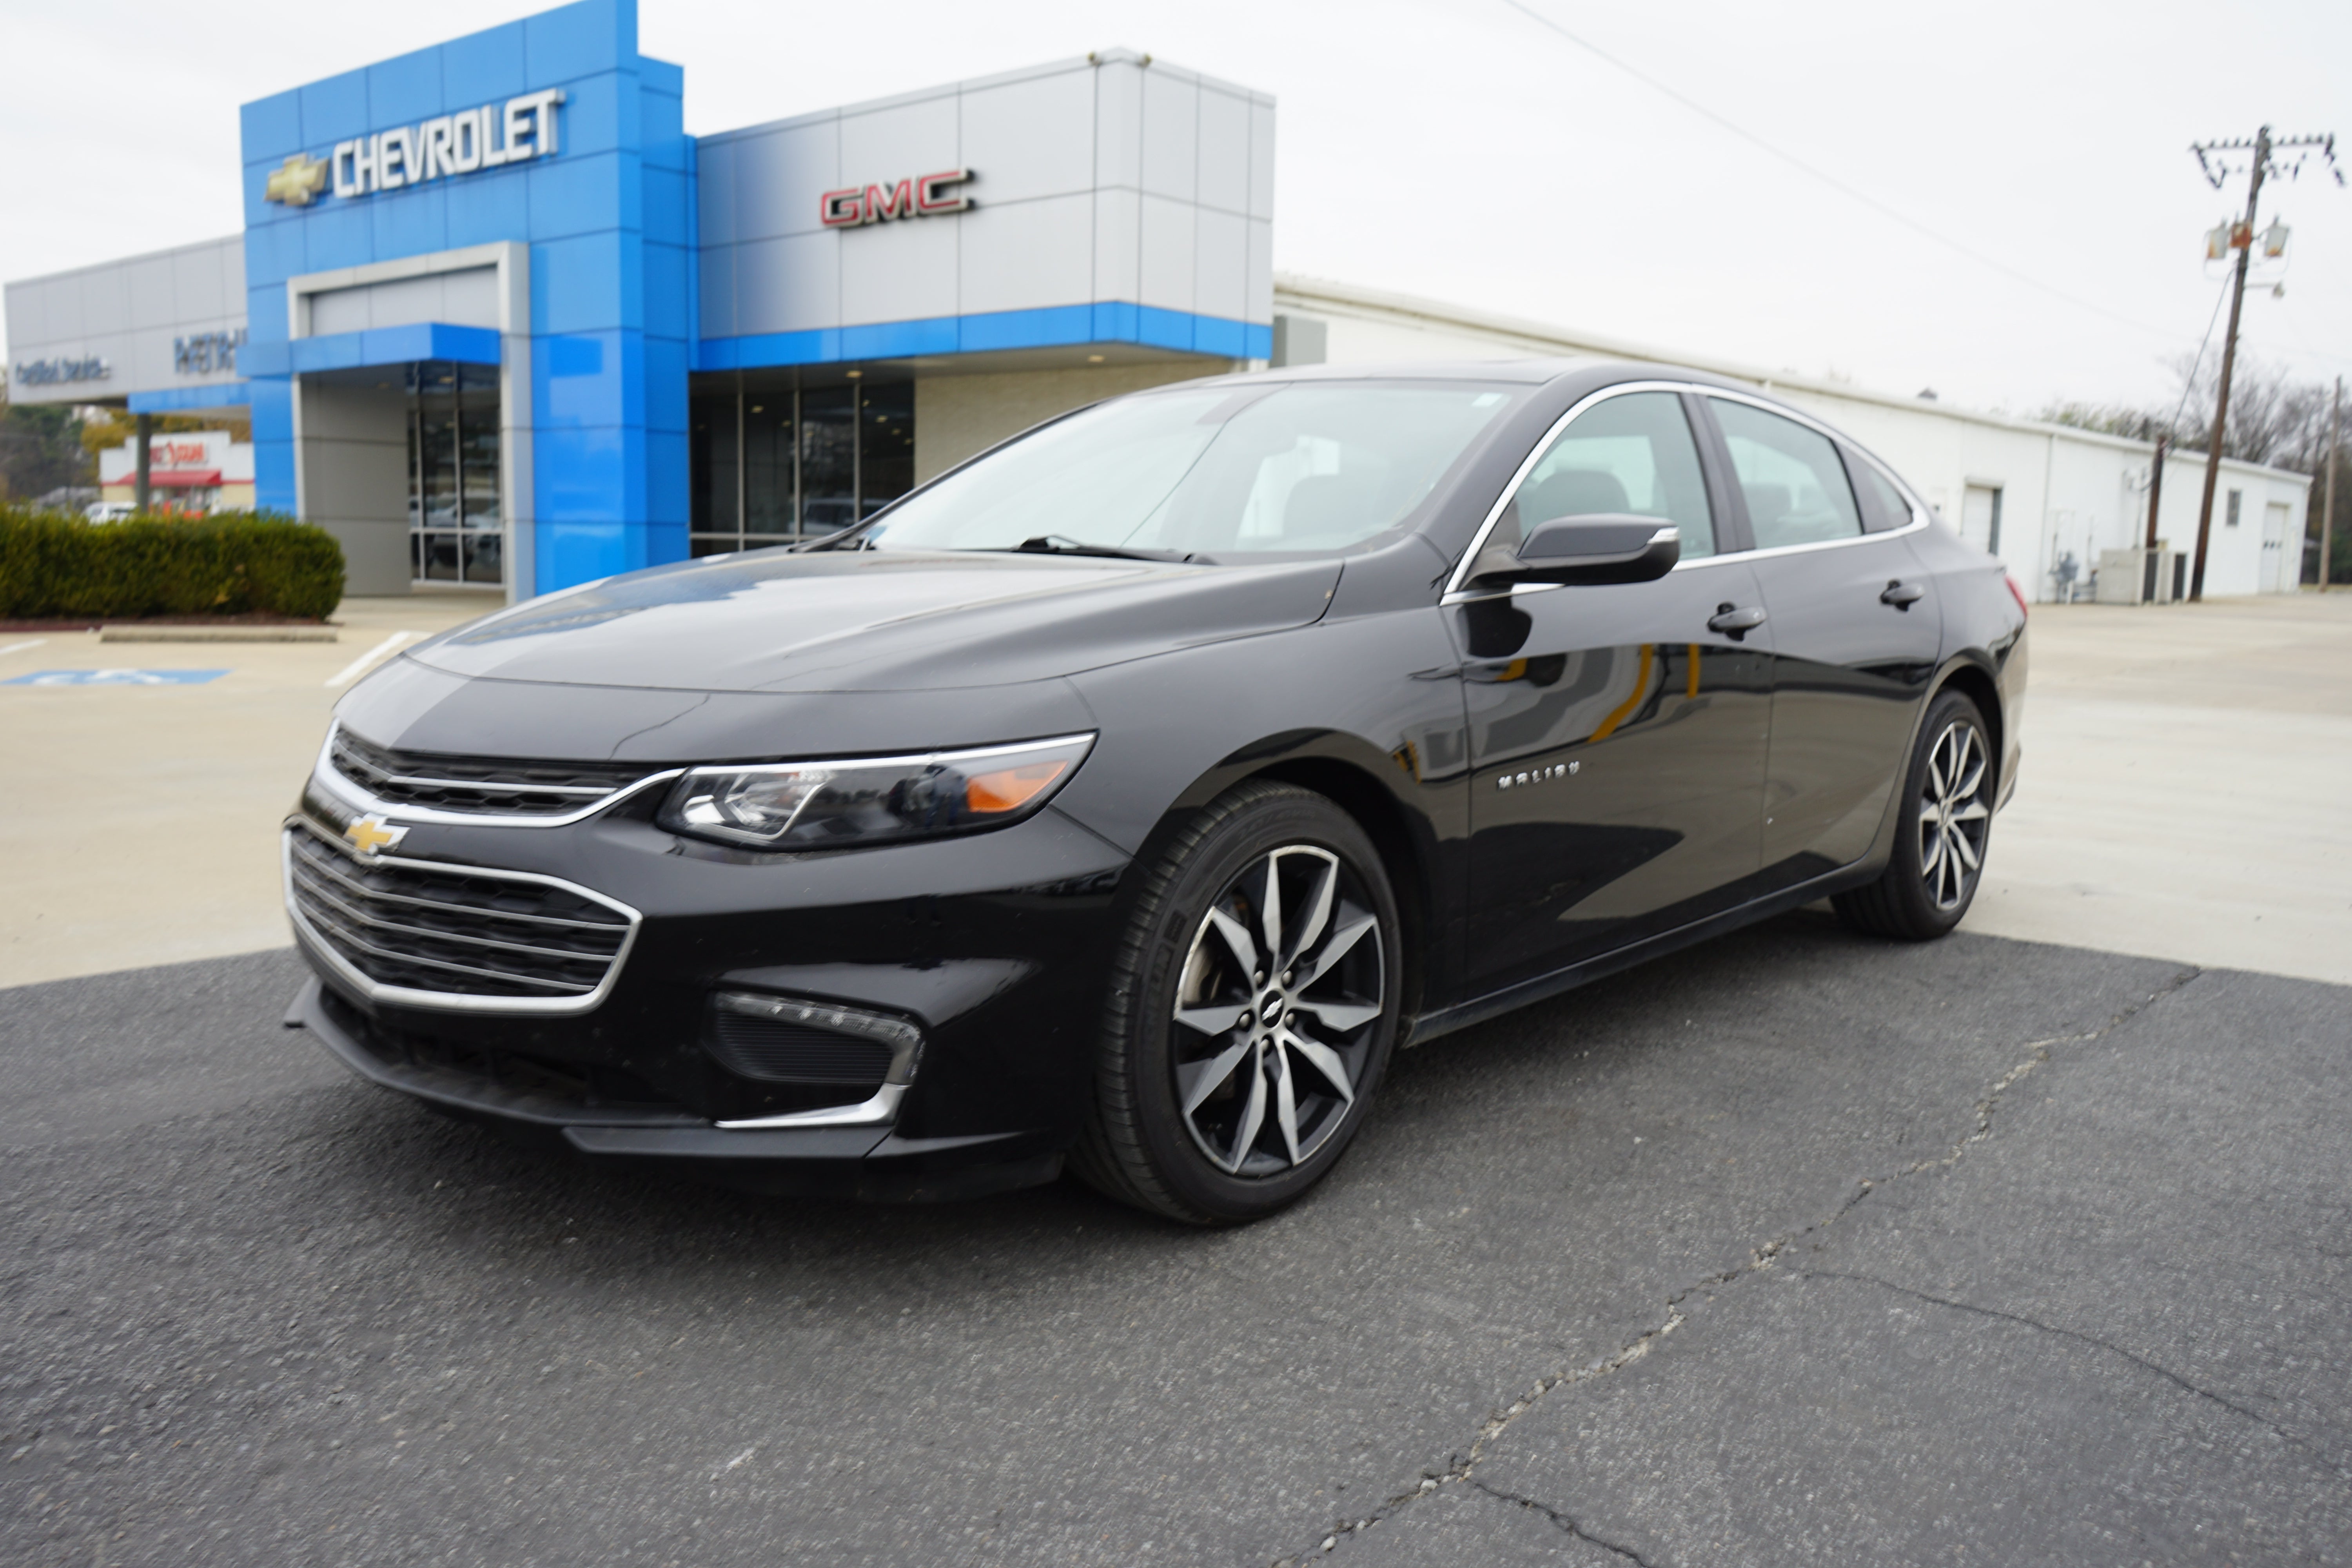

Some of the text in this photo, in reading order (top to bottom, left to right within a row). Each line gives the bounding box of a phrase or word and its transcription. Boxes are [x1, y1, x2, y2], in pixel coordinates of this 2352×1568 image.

[332, 87, 564, 198] CHEVROLET
[821, 168, 975, 228] GMC
[1498, 761, 1580, 789] MALIBU
